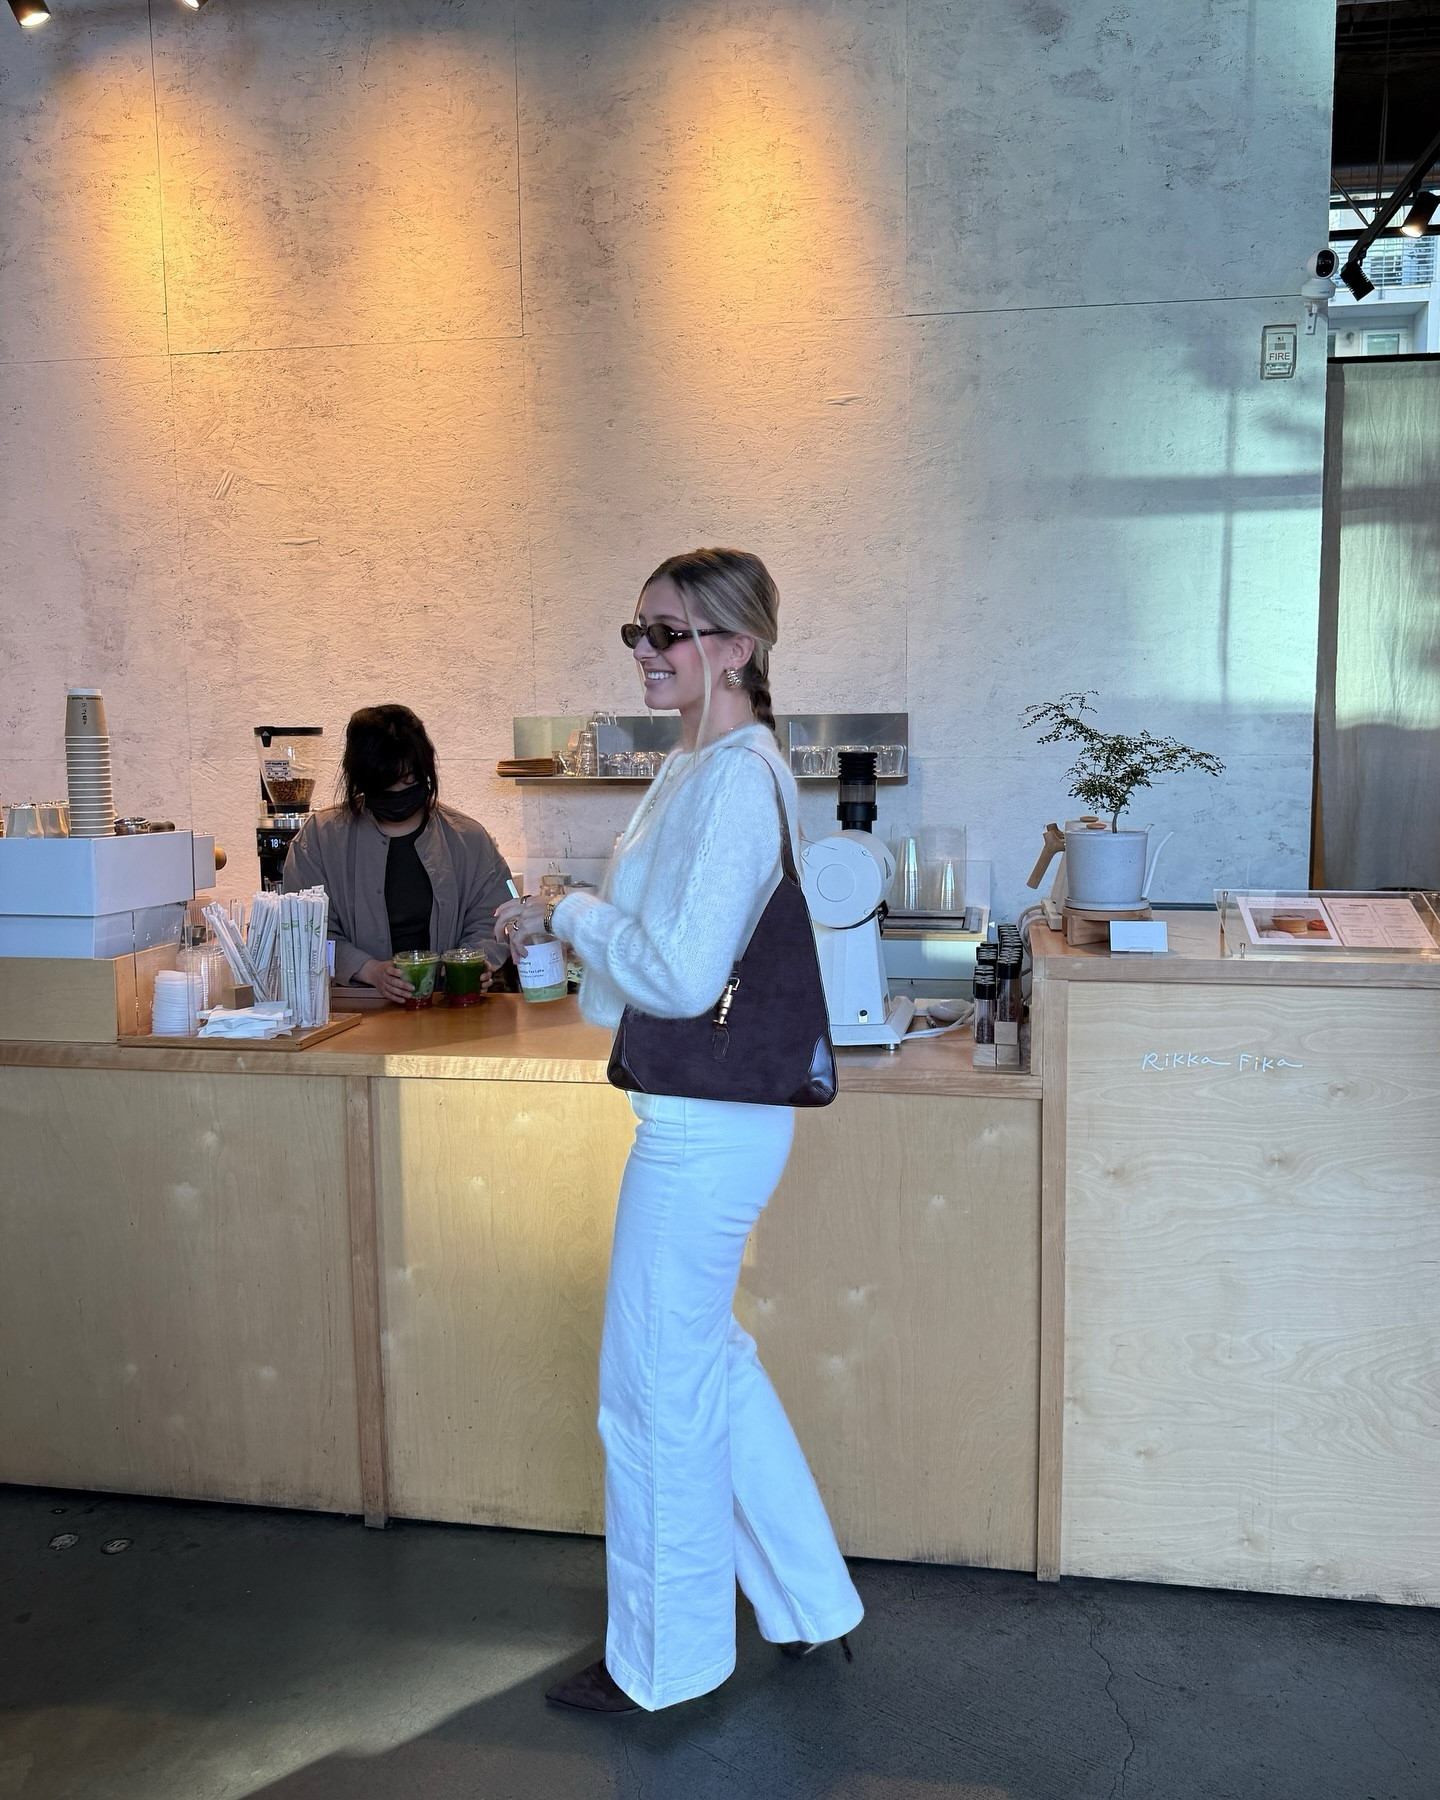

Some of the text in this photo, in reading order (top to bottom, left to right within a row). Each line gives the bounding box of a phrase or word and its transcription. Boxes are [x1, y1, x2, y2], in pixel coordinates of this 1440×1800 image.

[1269, 352, 1291, 361] FIRE
[1141, 1052, 1303, 1072] Rikka Fika
